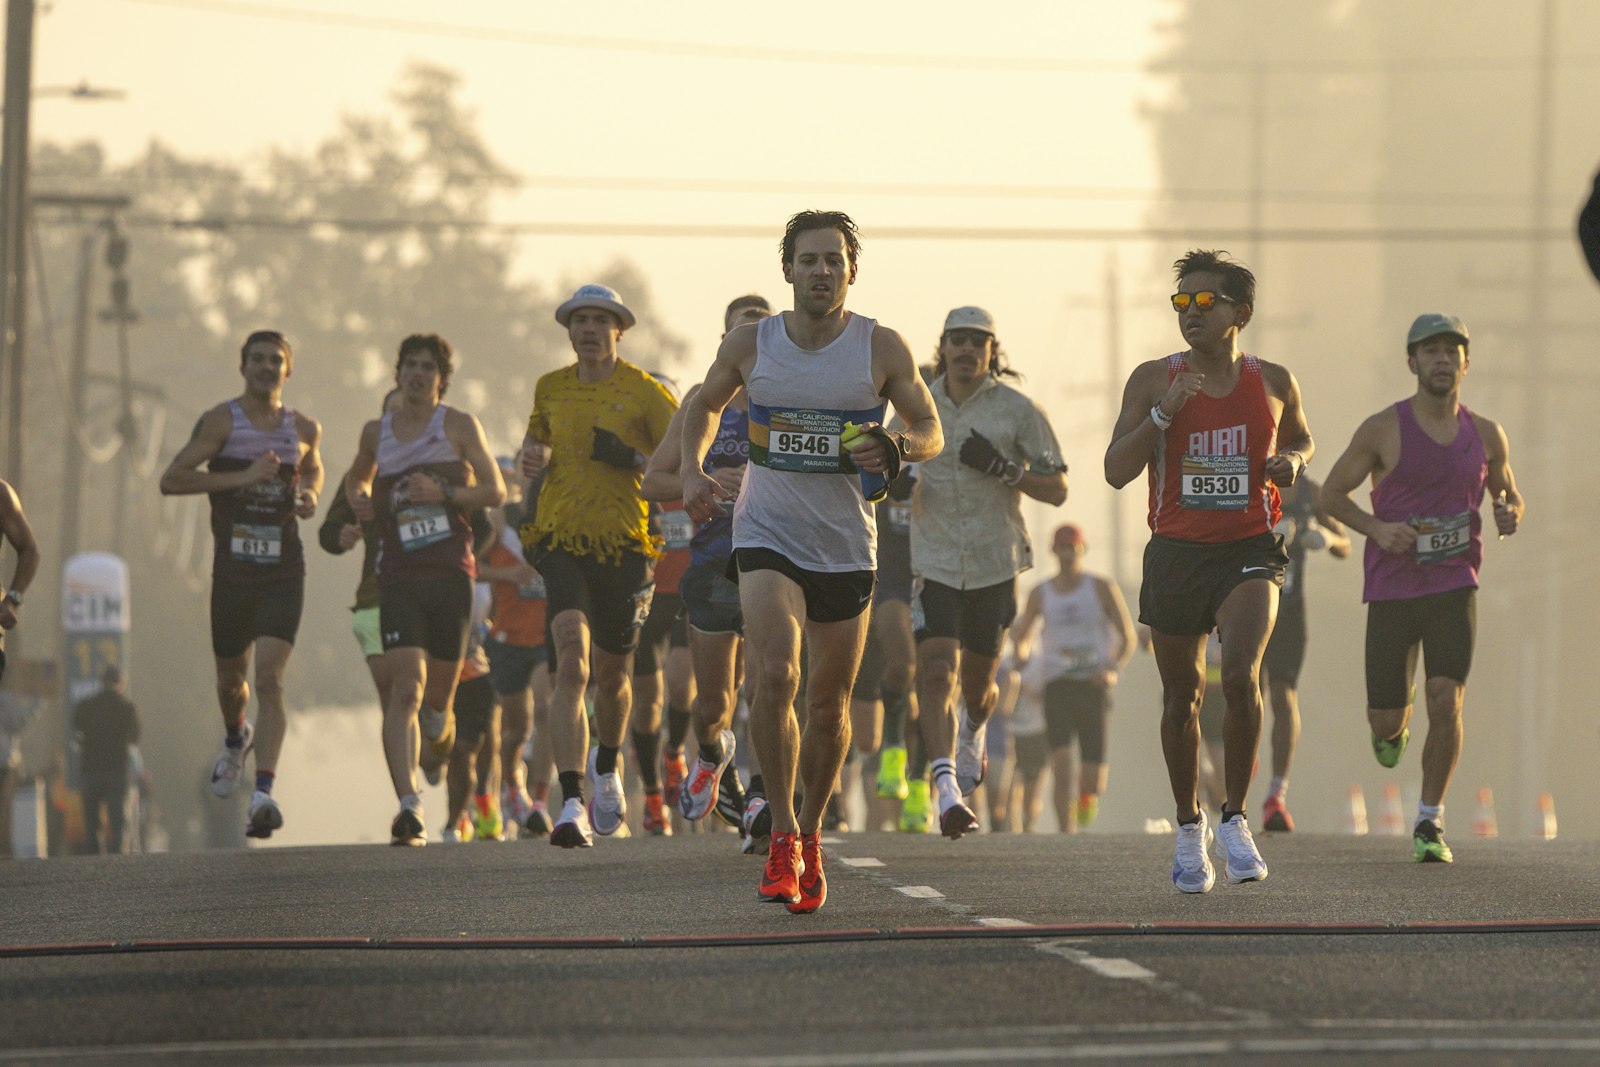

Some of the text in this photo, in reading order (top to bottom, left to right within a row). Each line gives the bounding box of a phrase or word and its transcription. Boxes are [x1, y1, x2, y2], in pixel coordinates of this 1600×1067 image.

[791, 419, 840, 427] INTERNATIONAL
[802, 413, 840, 421] CALIFORNIA
[778, 433, 830, 455] 9546
[1191, 476, 1239, 494] 9530
[409, 519, 437, 538] 612
[242, 539, 270, 555] 613
[1431, 532, 1460, 549] 623
